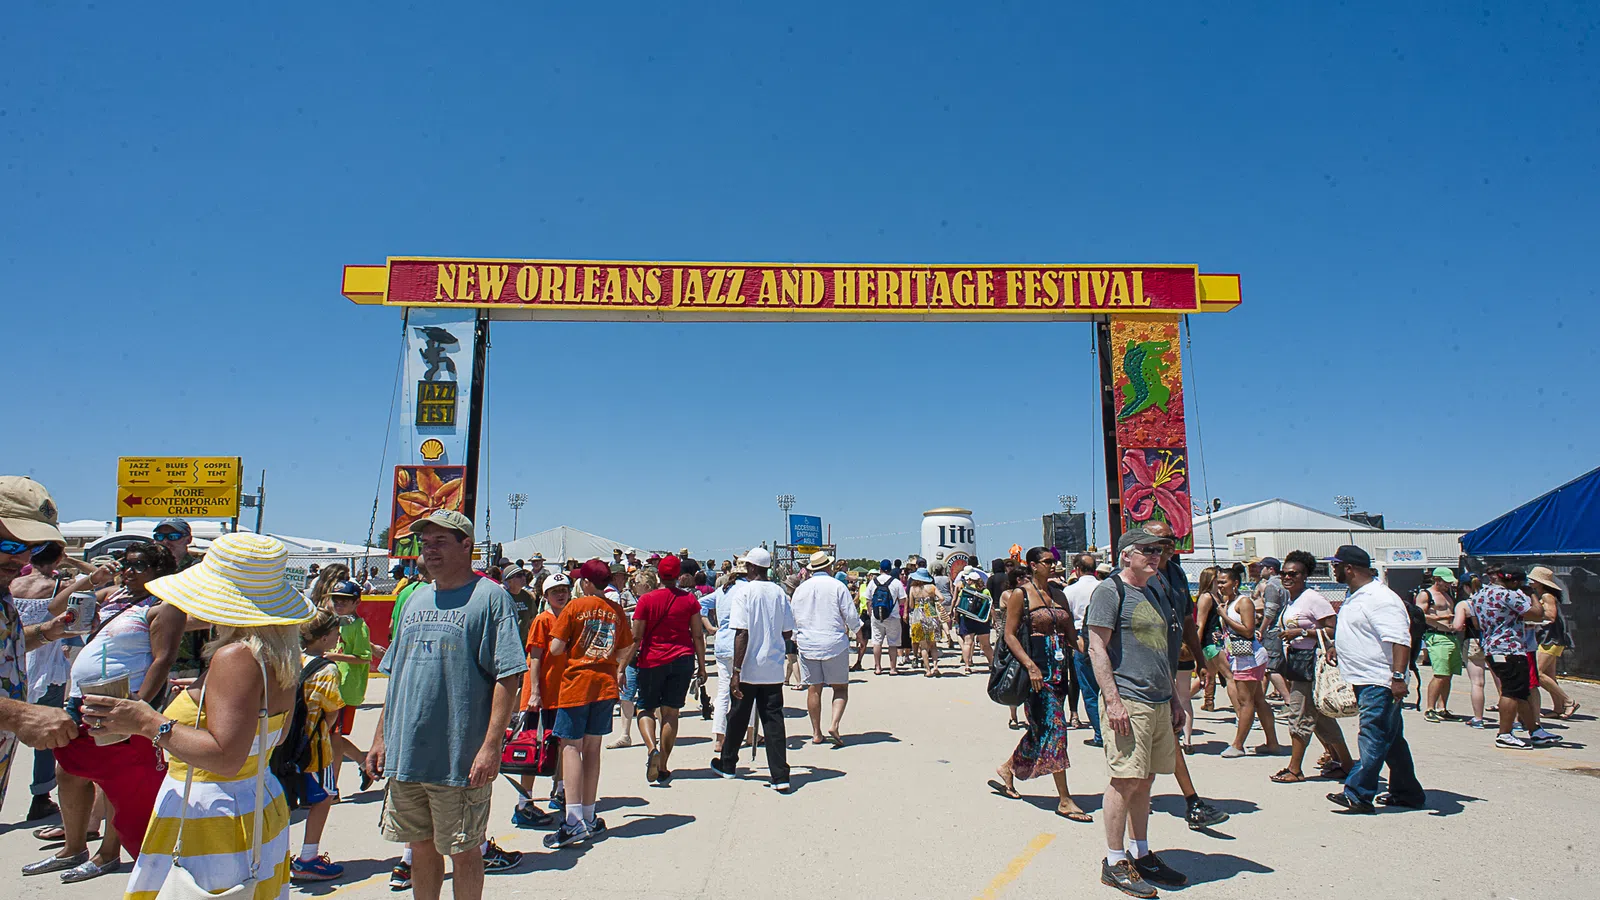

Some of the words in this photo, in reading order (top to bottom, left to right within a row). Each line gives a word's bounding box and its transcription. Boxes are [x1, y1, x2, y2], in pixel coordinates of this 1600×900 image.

[434, 263, 509, 302] NEW
[515, 265, 662, 305] ORLEANS
[668, 268, 746, 309] JAZZ
[756, 269, 826, 306] AND
[832, 270, 995, 307] HERITAGE
[1005, 270, 1152, 308] FESTIVAL
[419, 383, 455, 403] JAZZ
[417, 405, 454, 422] FEST
[173, 488, 205, 497] MORE
[144, 497, 231, 506] CONTEMPORARY
[167, 506, 208, 515] CRAFTS
[938, 525, 974, 549] Lite
[283, 573, 305, 582] ECYCLE
[285, 567, 305, 575] PLEASE
[440, 610, 467, 629] ANA
